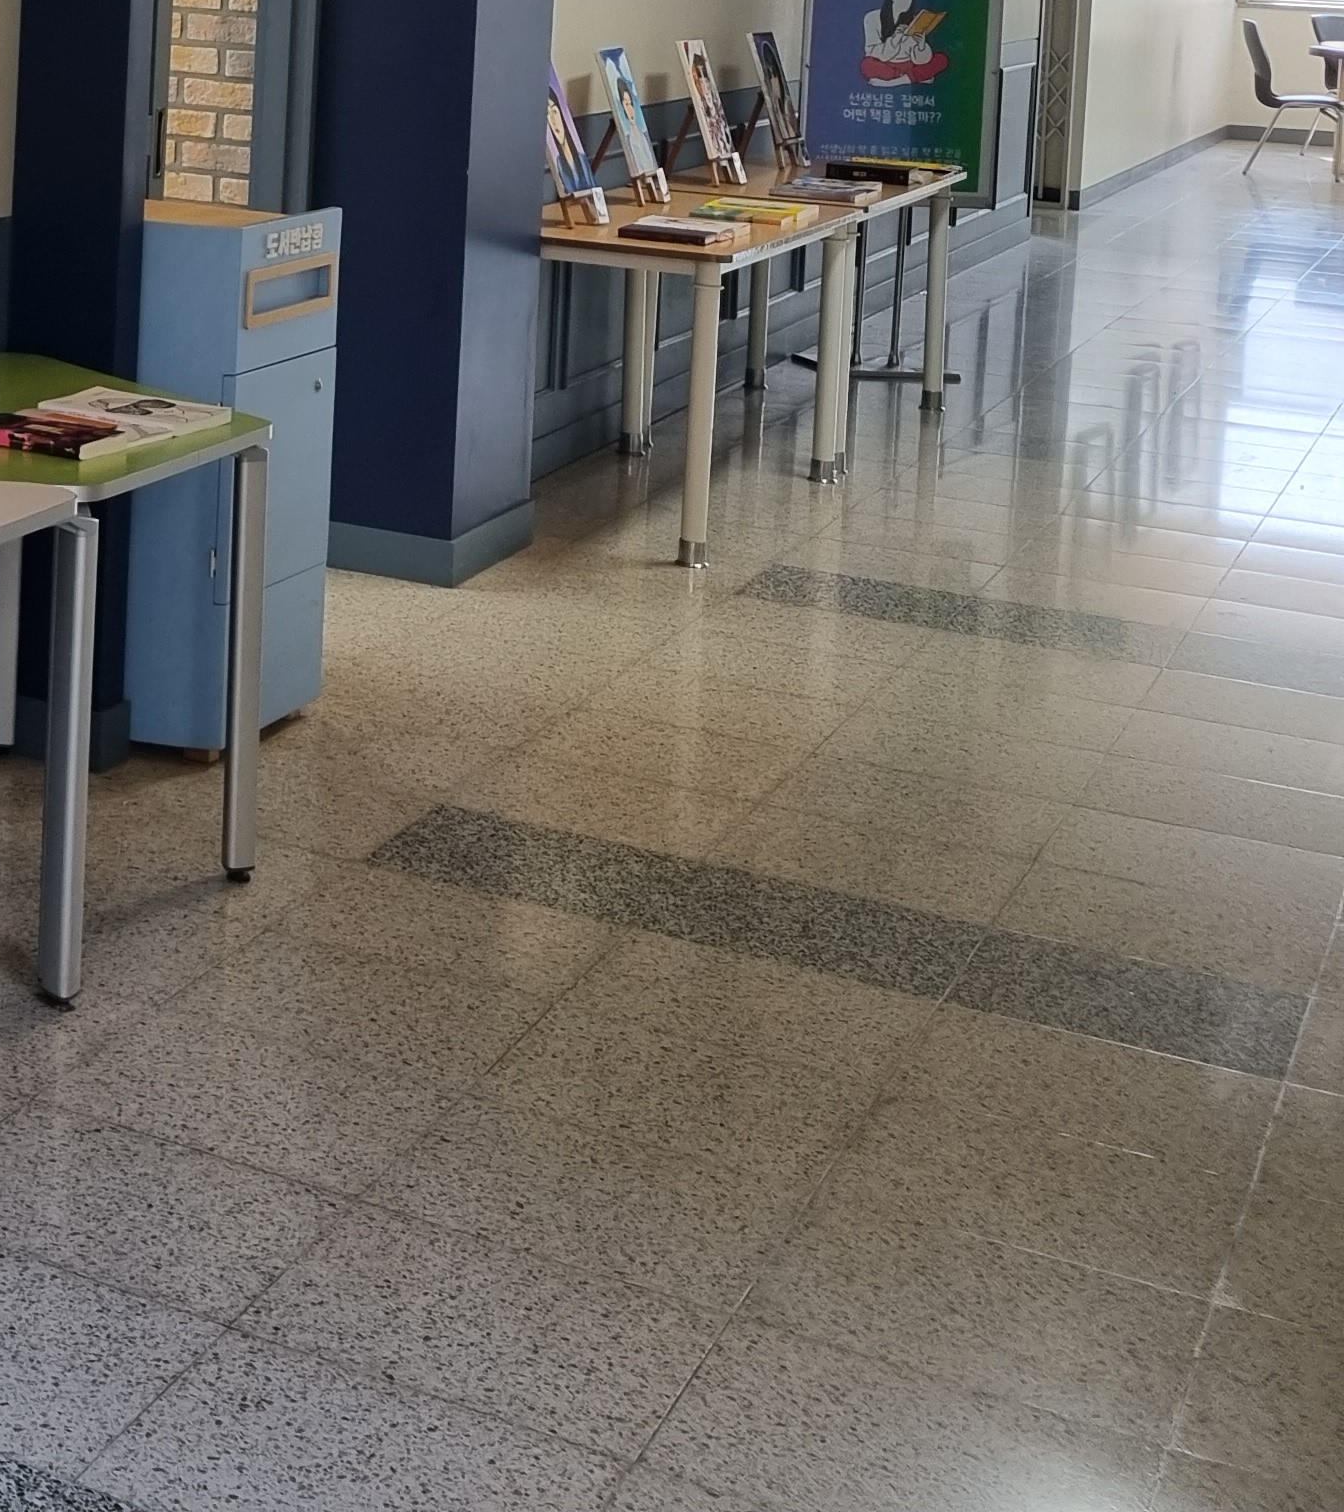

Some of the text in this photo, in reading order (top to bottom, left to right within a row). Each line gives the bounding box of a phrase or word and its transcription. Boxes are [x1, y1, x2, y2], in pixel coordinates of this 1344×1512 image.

[849, 93, 935, 108] 선생님은 집에서
[843, 108, 942, 125] 어떤 책을 읽을까??
[266, 222, 324, 259] 도서반납함
